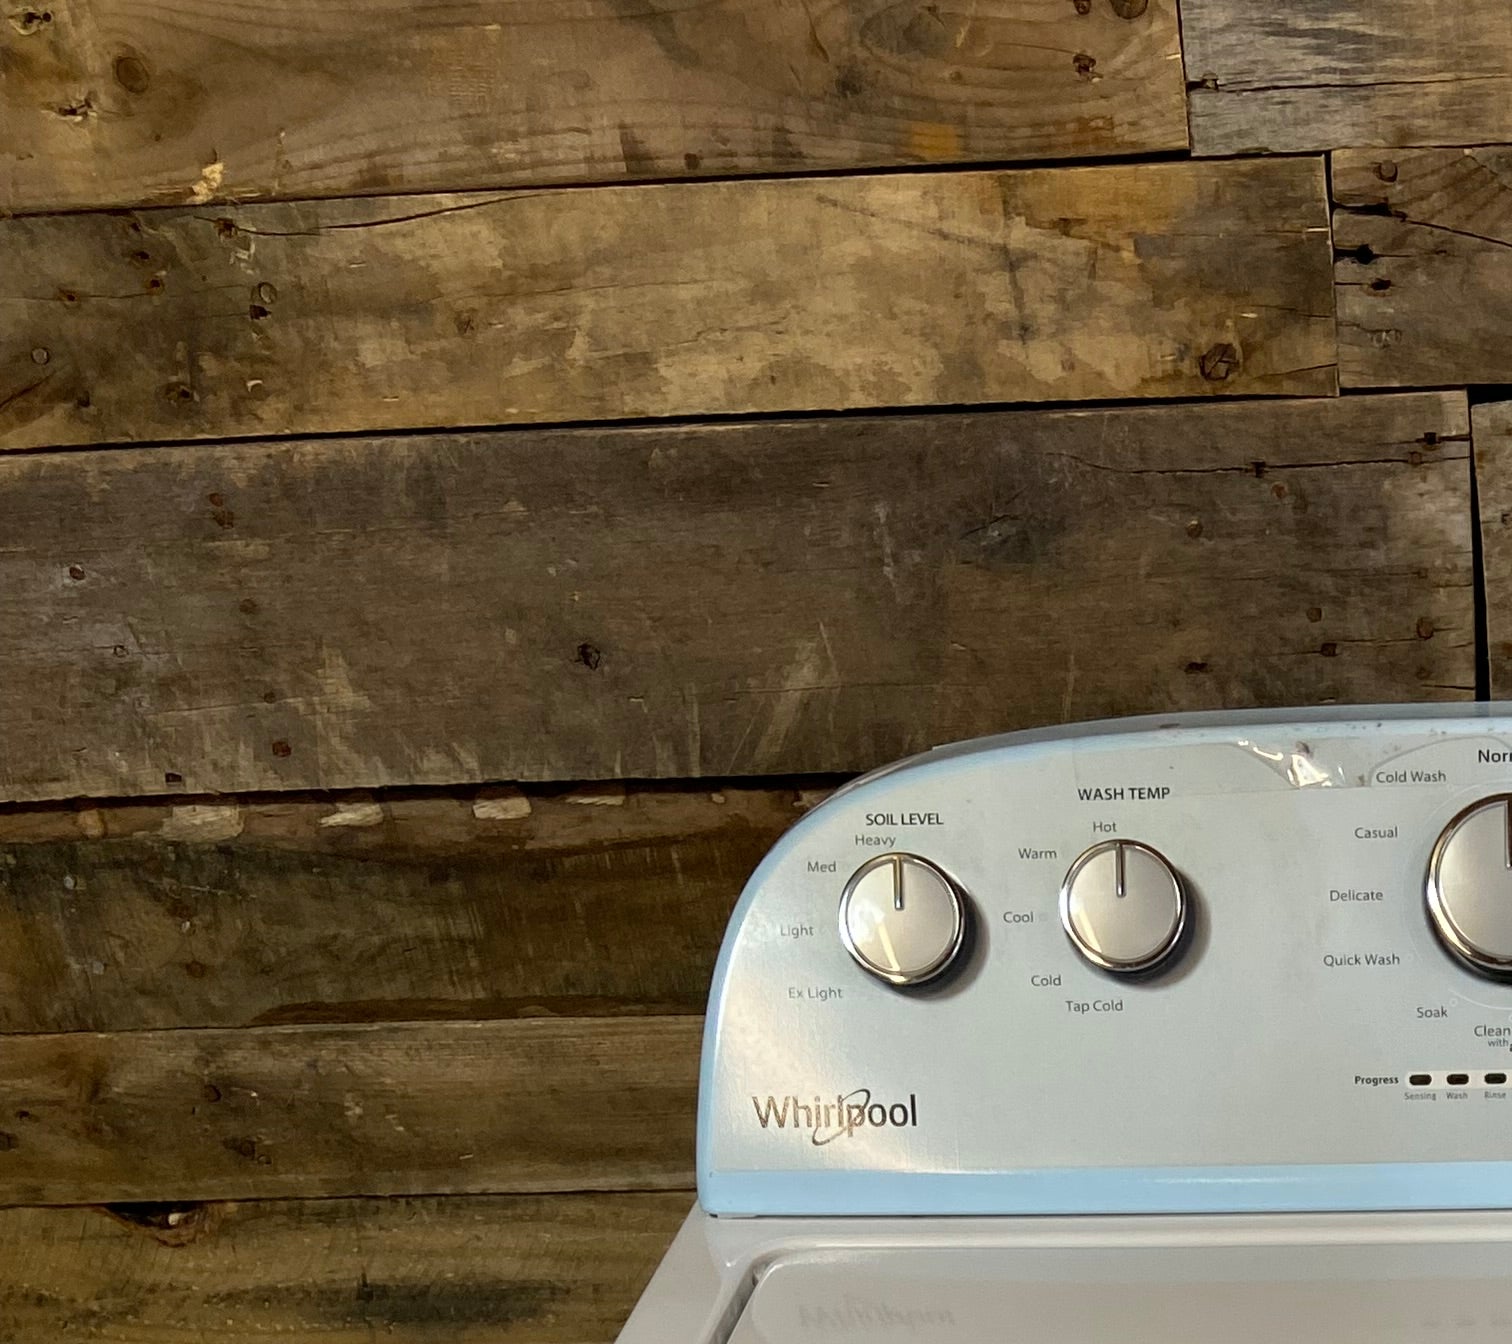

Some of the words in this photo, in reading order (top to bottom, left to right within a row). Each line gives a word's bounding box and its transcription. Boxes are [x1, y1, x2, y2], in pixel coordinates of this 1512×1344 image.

[1376, 771, 1407, 783] Cold
[1412, 770, 1446, 782] Wash
[1078, 788, 1124, 800] WASH
[1128, 787, 1170, 799] TEMP
[866, 814, 897, 825] SOIL
[901, 813, 944, 825] LEVEL
[1093, 822, 1116, 832] Hot
[1355, 826, 1397, 839] Casual
[855, 835, 896, 848] Heavy
[1019, 848, 1057, 859] Warm
[808, 861, 836, 872] Med
[1330, 890, 1383, 901] Delicate
[1003, 911, 1033, 923] Cool
[781, 924, 814, 939] Light
[1324, 954, 1361, 967] Quick
[1365, 954, 1400, 965] Wash
[1031, 975, 1061, 986] Cold
[789, 987, 803, 998] Ex
[808, 987, 843, 1001] Light
[1066, 1001, 1089, 1014] Tap
[1093, 1000, 1123, 1011] Cold
[1417, 1006, 1448, 1018] Soak
[1474, 1024, 1511, 1038] Clean
[1487, 1038, 1509, 1047] with
[1355, 1076, 1398, 1086] Progress
[1405, 1091, 1437, 1101] Sensing
[1446, 1091, 1468, 1099] Wash
[750, 1088, 918, 1147] Whirlpool
